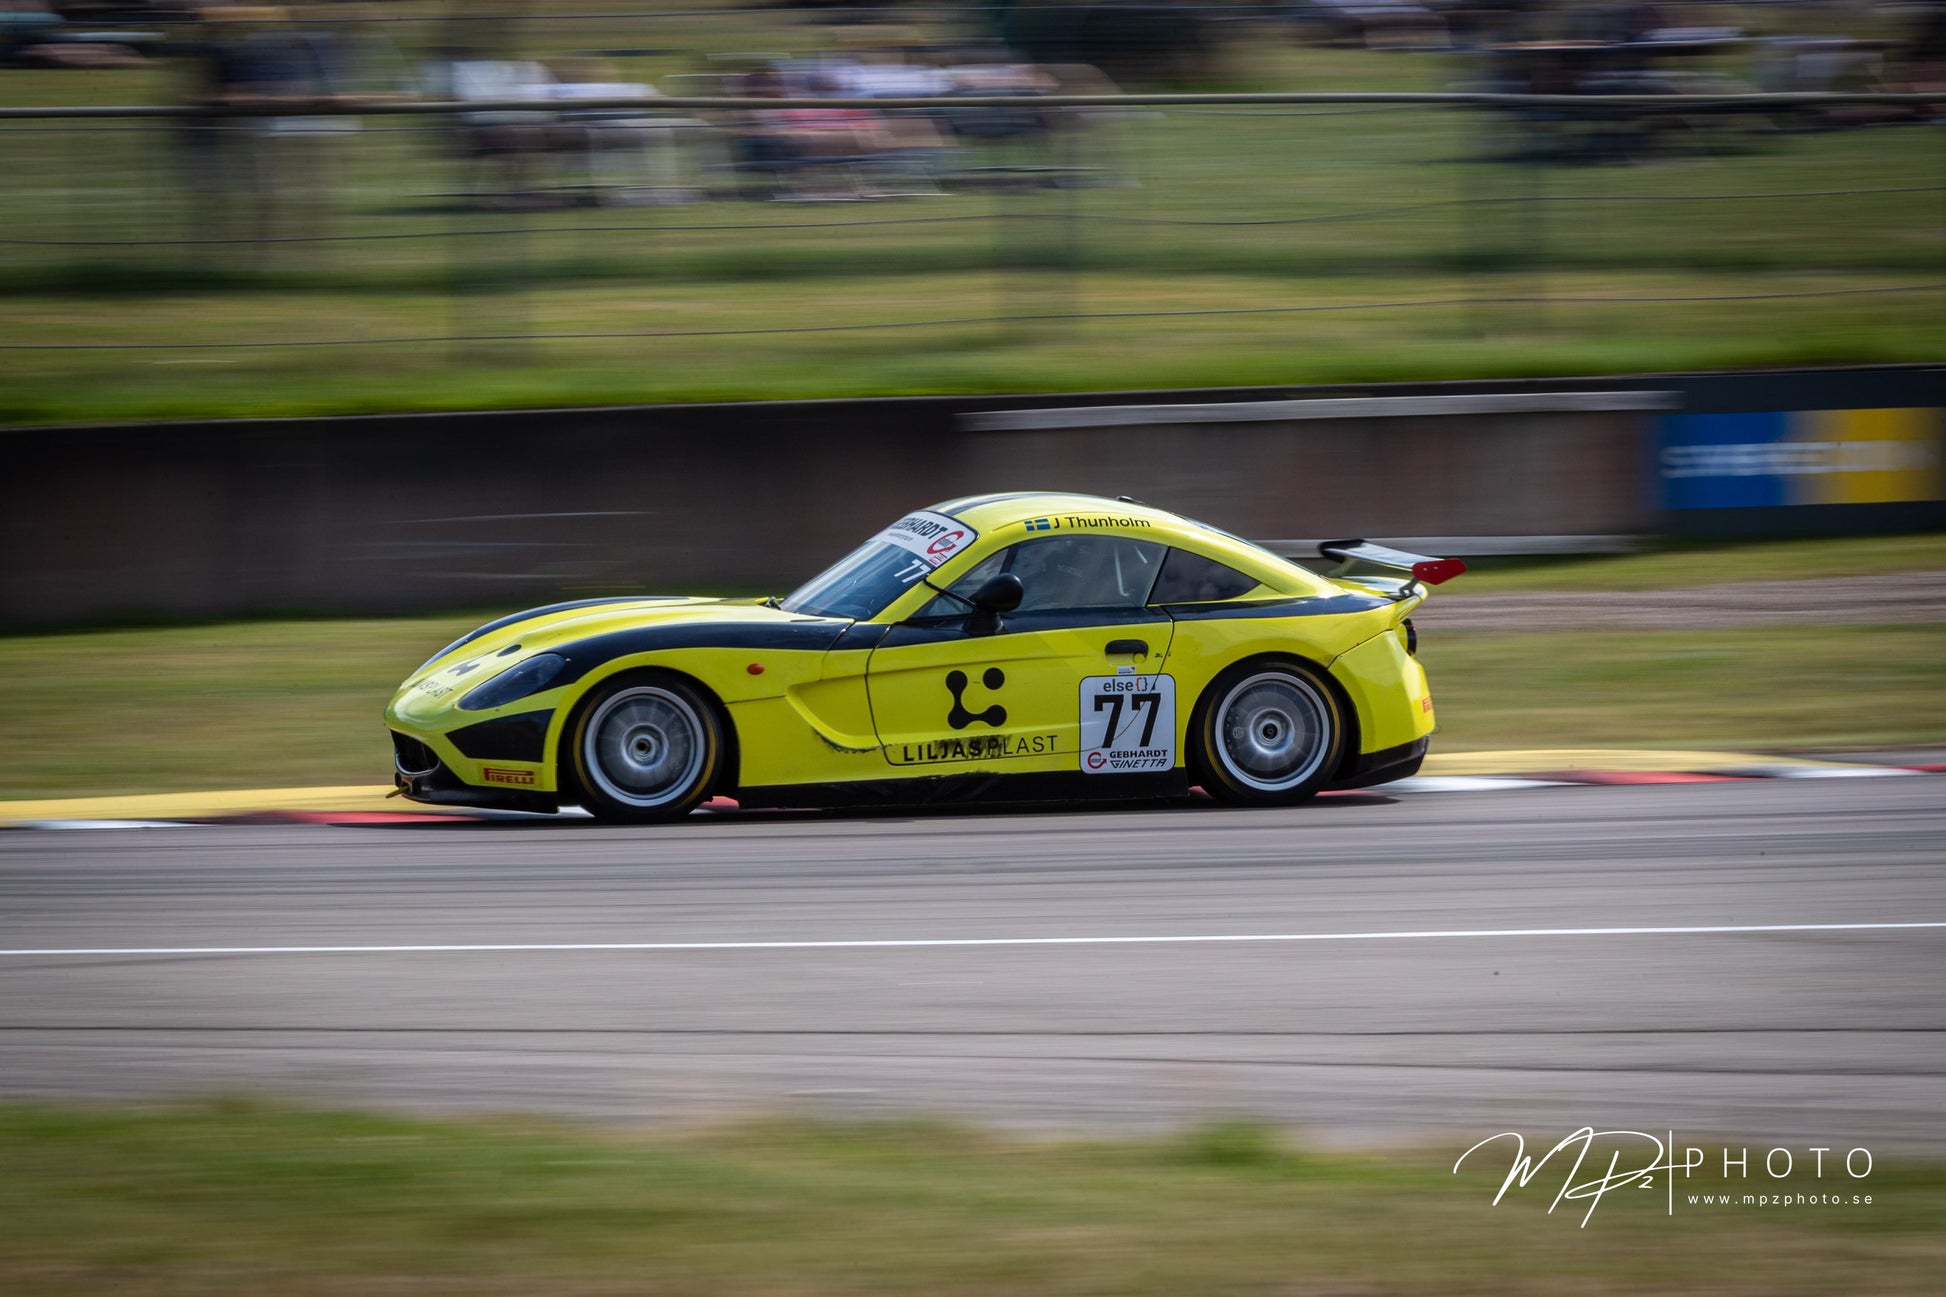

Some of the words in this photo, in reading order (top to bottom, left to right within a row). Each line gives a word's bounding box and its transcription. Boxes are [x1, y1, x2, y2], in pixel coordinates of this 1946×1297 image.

[1053, 517, 1060, 529] J
[1065, 517, 1151, 528] Thunholm
[893, 559, 931, 583] 77
[1094, 693, 1161, 748] 77
[903, 735, 1058, 762] LILJASPLAST
[1109, 749, 1168, 759] GEBHARDT
[1110, 758, 1167, 769] GINETTA
[483, 768, 534, 784] PIRELLI
